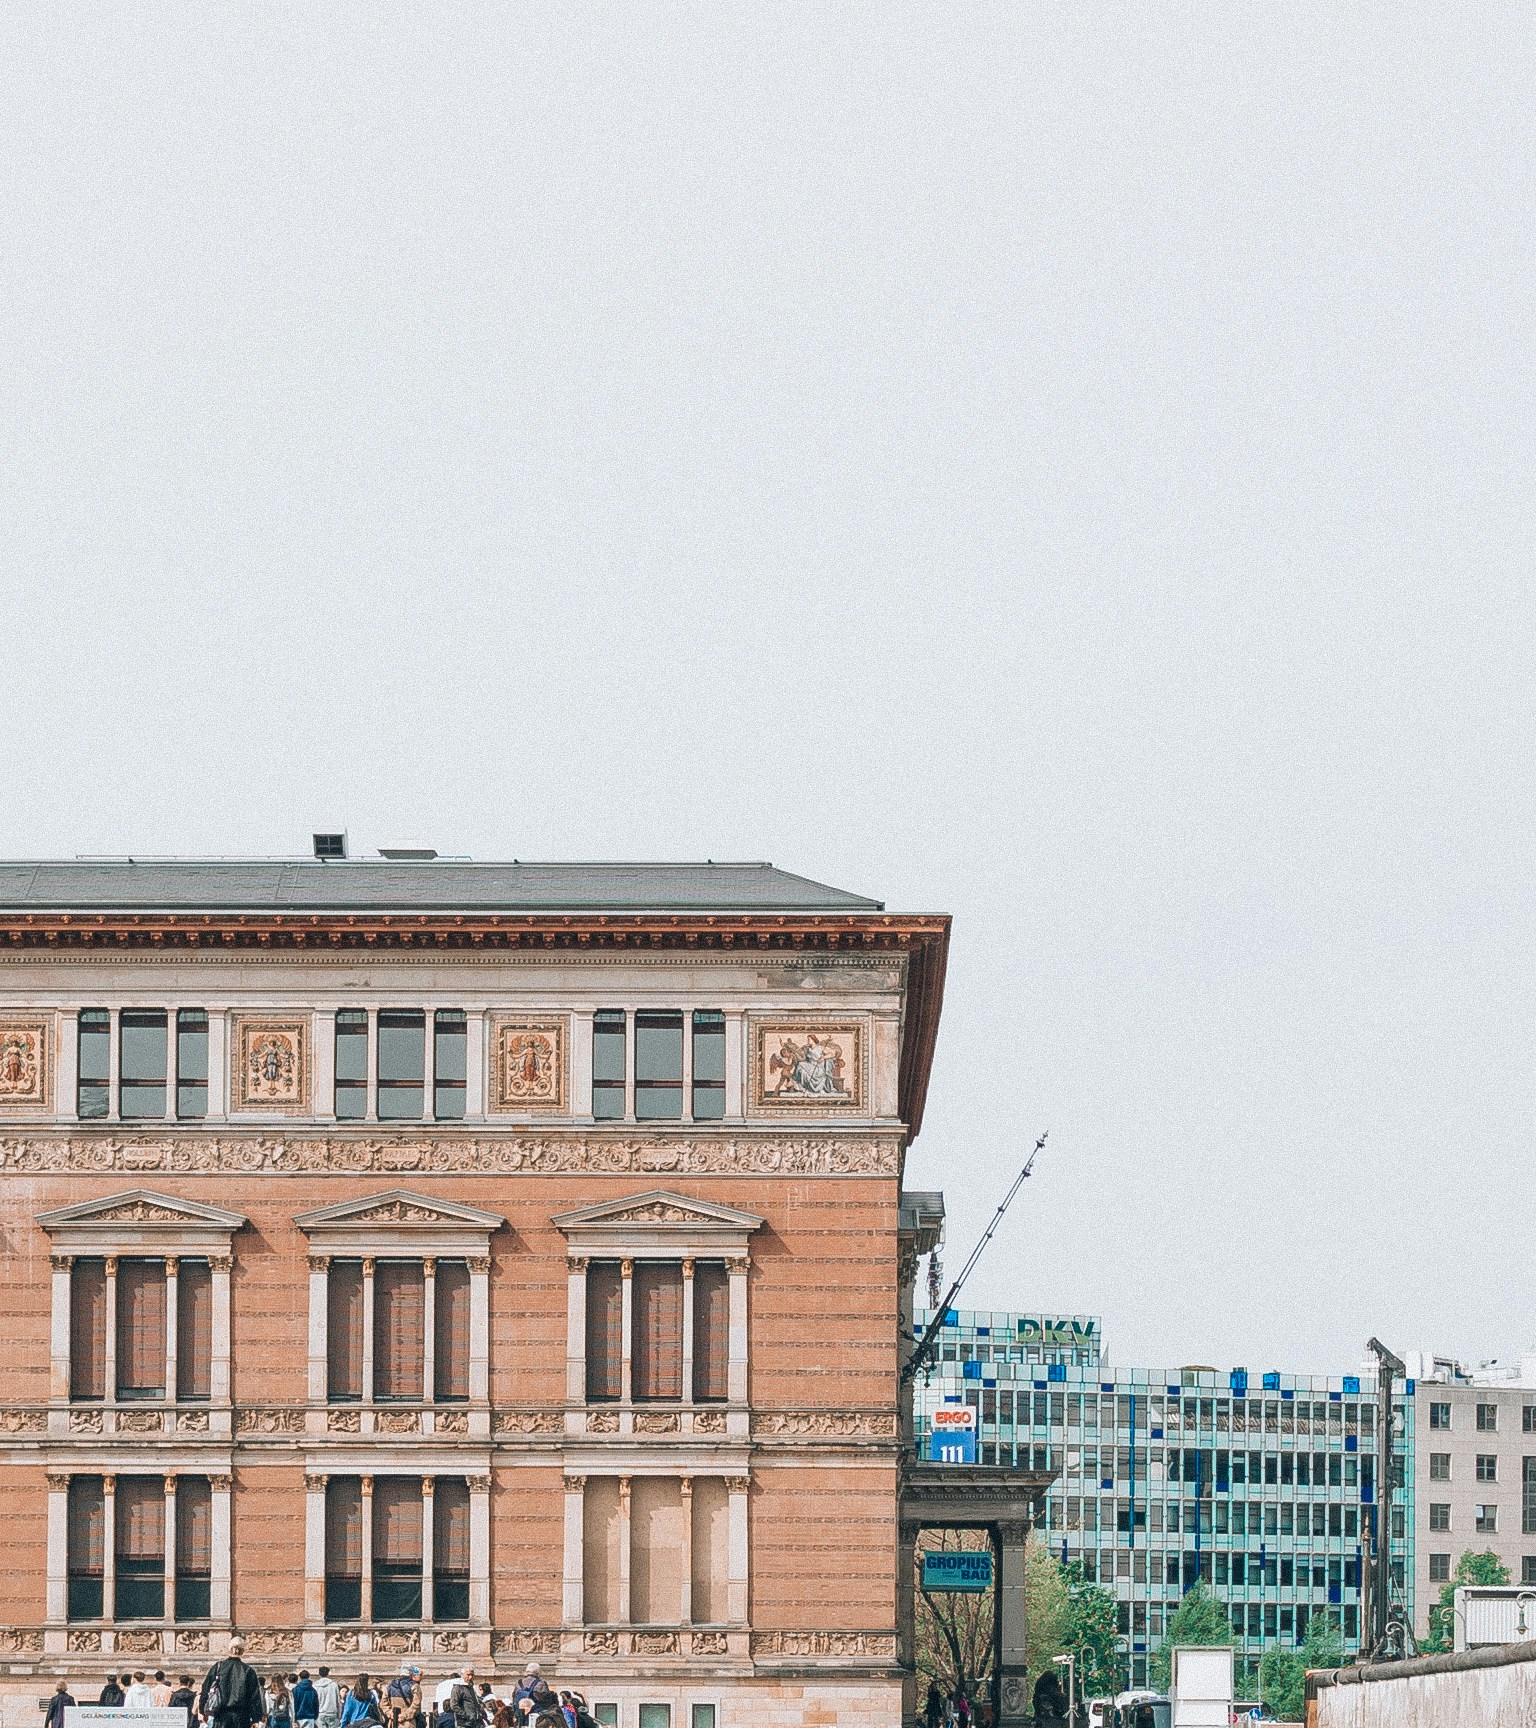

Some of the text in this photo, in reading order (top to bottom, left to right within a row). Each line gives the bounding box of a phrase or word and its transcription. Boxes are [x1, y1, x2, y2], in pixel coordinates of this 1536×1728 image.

[1016, 1318, 1095, 1344] DKV
[935, 1411, 971, 1424] ERGO
[940, 1445, 963, 1463] 111
[926, 1556, 990, 1570] GROPIUS
[961, 1569, 990, 1581] BAU
